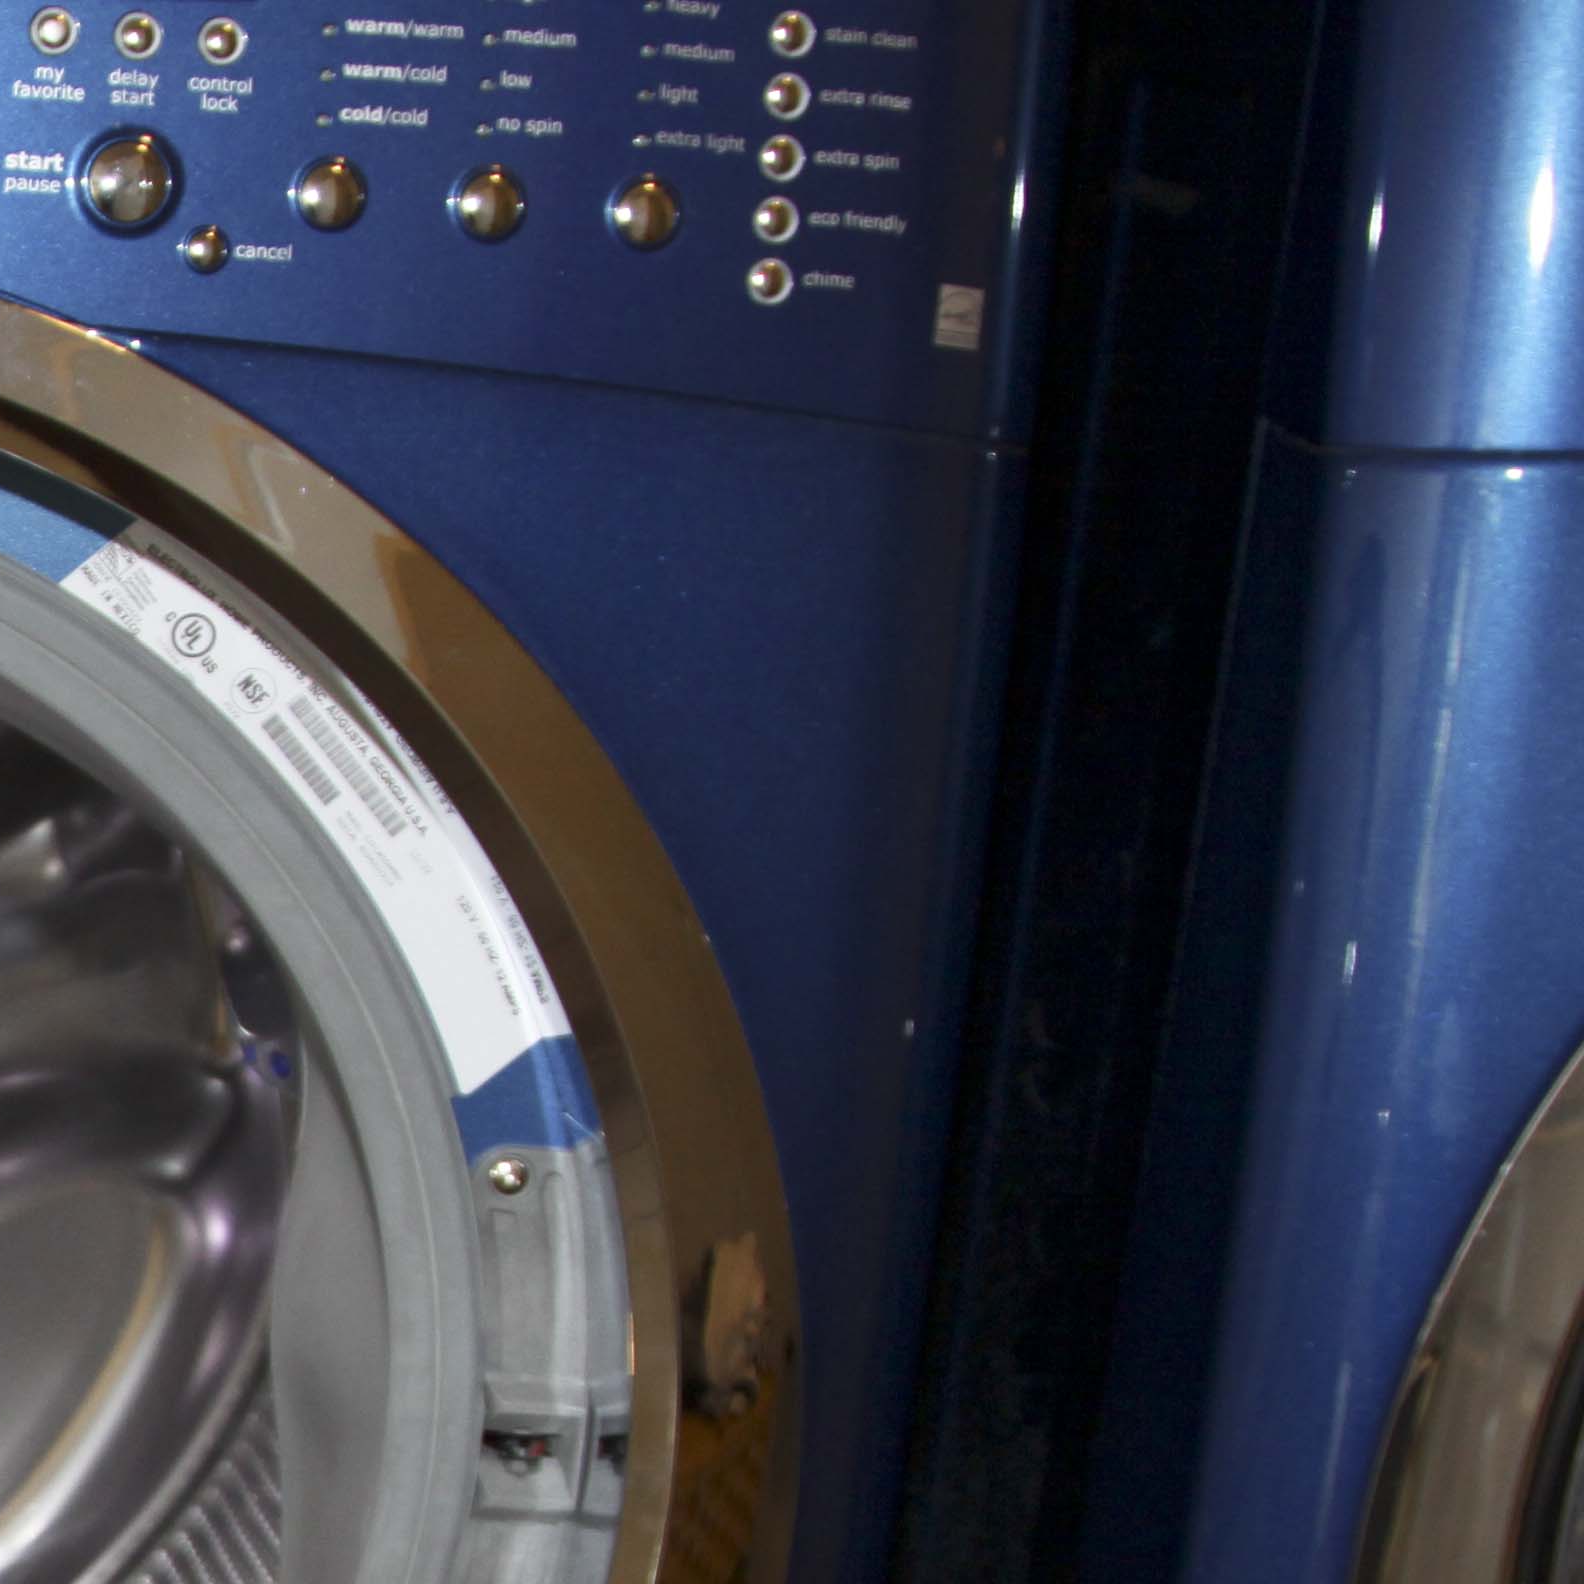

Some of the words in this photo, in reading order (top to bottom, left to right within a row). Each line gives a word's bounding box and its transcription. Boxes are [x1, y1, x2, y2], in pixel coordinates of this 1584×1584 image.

[344, 18, 465, 40] warm/warm
[502, 28, 578, 48] medium
[824, 26, 868, 44] stain
[871, 31, 919, 49] clean
[662, 42, 735, 63] medium
[35, 65, 65, 85] my
[108, 68, 159, 89] delay
[342, 62, 448, 83] warm/cold
[499, 70, 532, 89] low
[12, 80, 86, 102] favorite
[188, 76, 253, 94] control
[659, 83, 699, 105] light
[110, 89, 155, 106] start
[201, 94, 239, 112] lock
[820, 88, 865, 105] extra
[869, 93, 913, 111] rinse
[338, 105, 429, 127] cold/cold
[497, 116, 521, 132] no
[524, 118, 564, 137] spin
[655, 131, 701, 148] extra
[706, 134, 746, 154] light
[4, 150, 65, 172] start
[813, 149, 860, 167] extra
[863, 153, 900, 172] spin
[3, 176, 61, 194] pause
[808, 211, 839, 228] eco
[843, 211, 907, 236] friendly
[235, 242, 293, 261] cancel
[802, 270, 856, 290] chime
[200, 656, 219, 674] US
[237, 673, 271, 705] NSF
